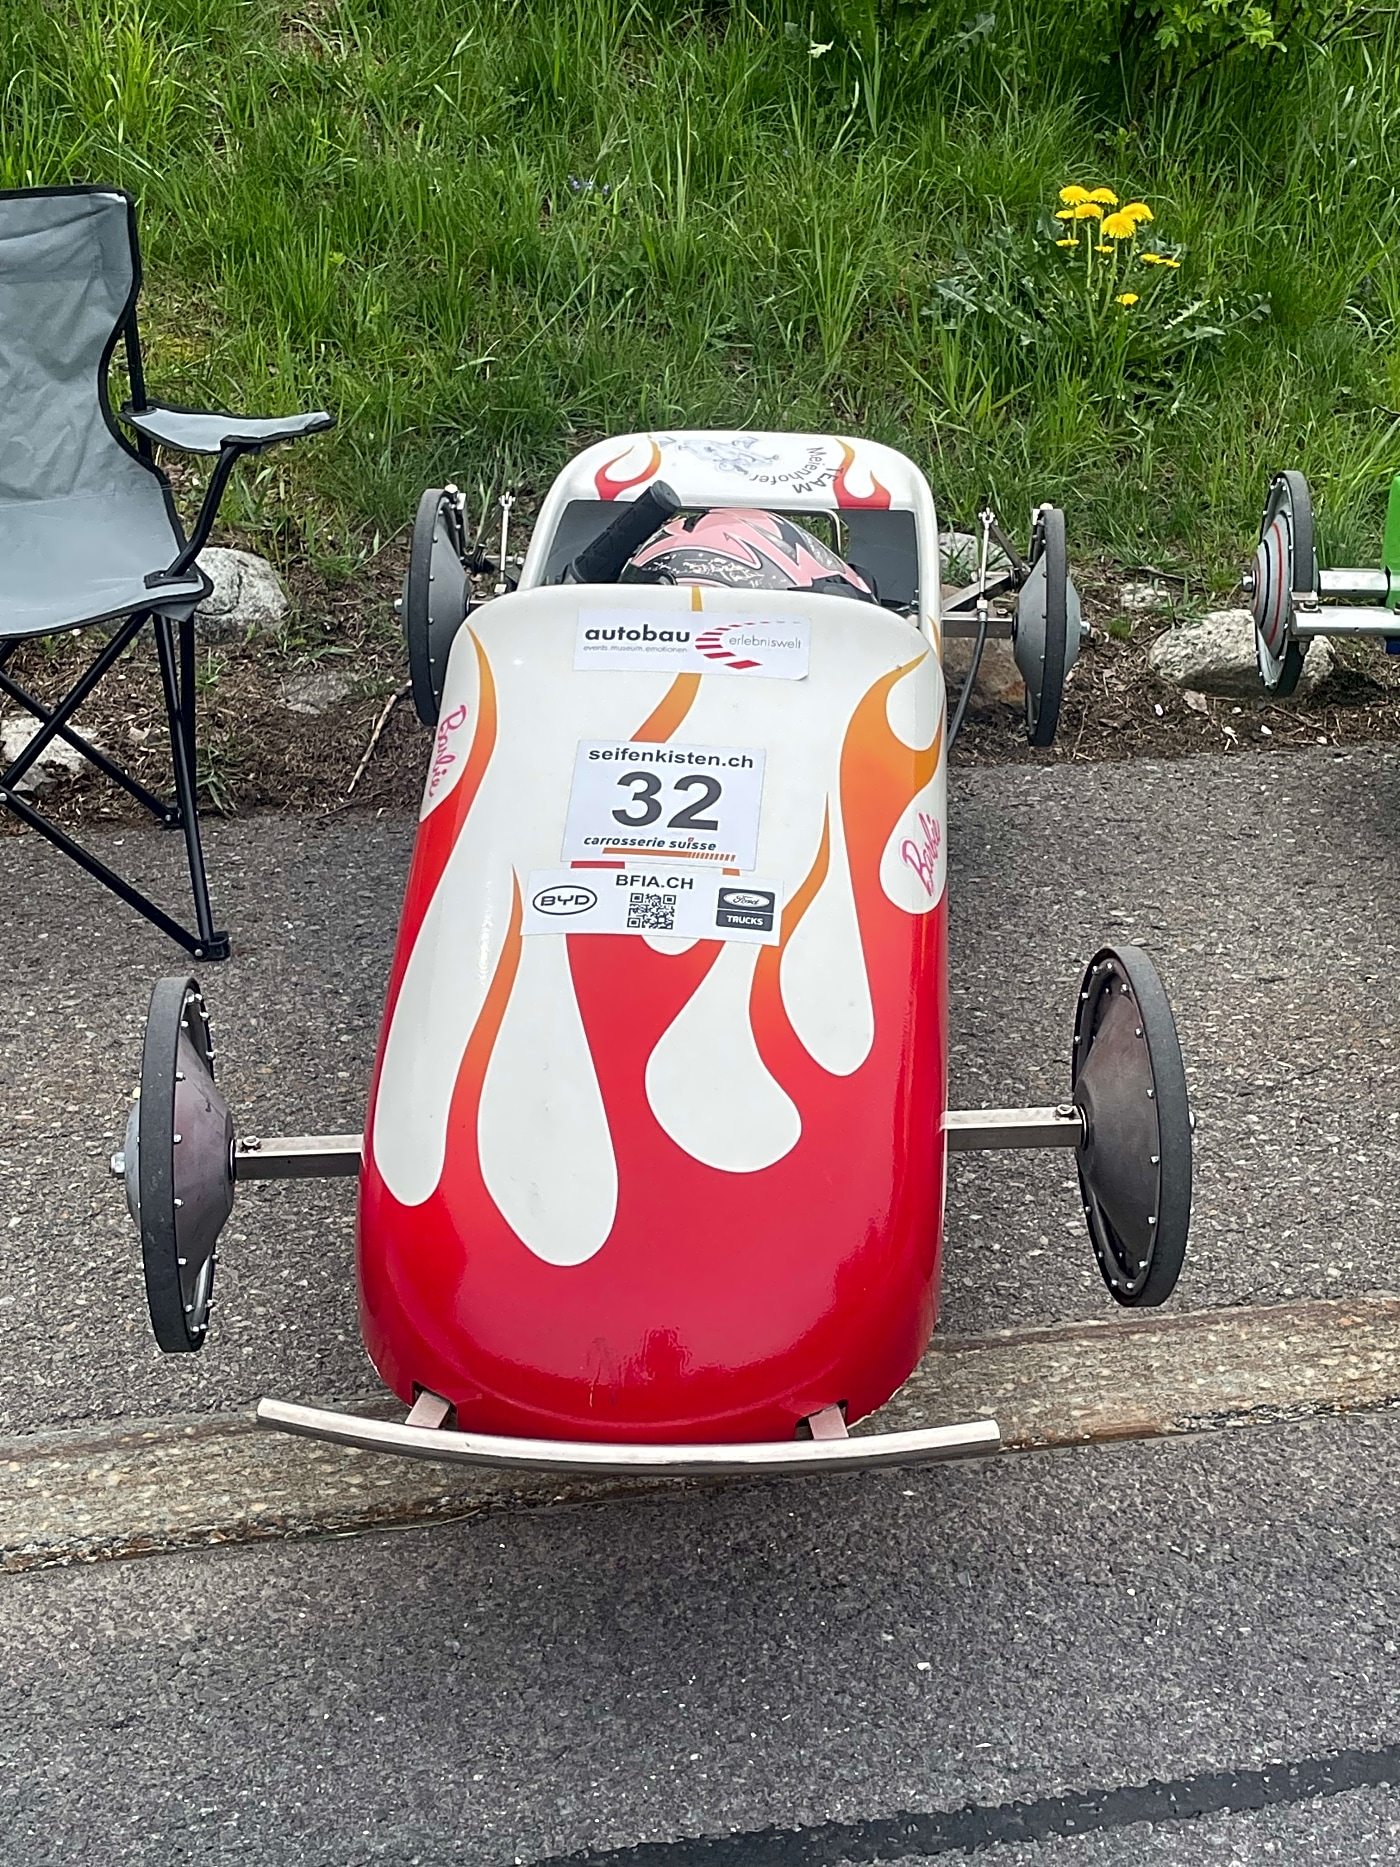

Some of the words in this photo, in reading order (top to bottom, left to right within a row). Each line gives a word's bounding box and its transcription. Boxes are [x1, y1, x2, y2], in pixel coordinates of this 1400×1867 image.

[749, 446, 827, 486] Meienhofer
[791, 467, 844, 494] TEAM
[584, 623, 691, 643] autobau
[728, 634, 802, 650] erlebniswelt
[588, 747, 754, 769] seifenkisten.ch
[611, 771, 722, 831] 32
[583, 836, 666, 848] carrosserie
[669, 837, 717, 851] suisse
[615, 874, 694, 890] BFIA.CH
[540, 894, 590, 907] BYD
[732, 895, 761, 906] Ford
[726, 914, 764, 926] TRUCKS
